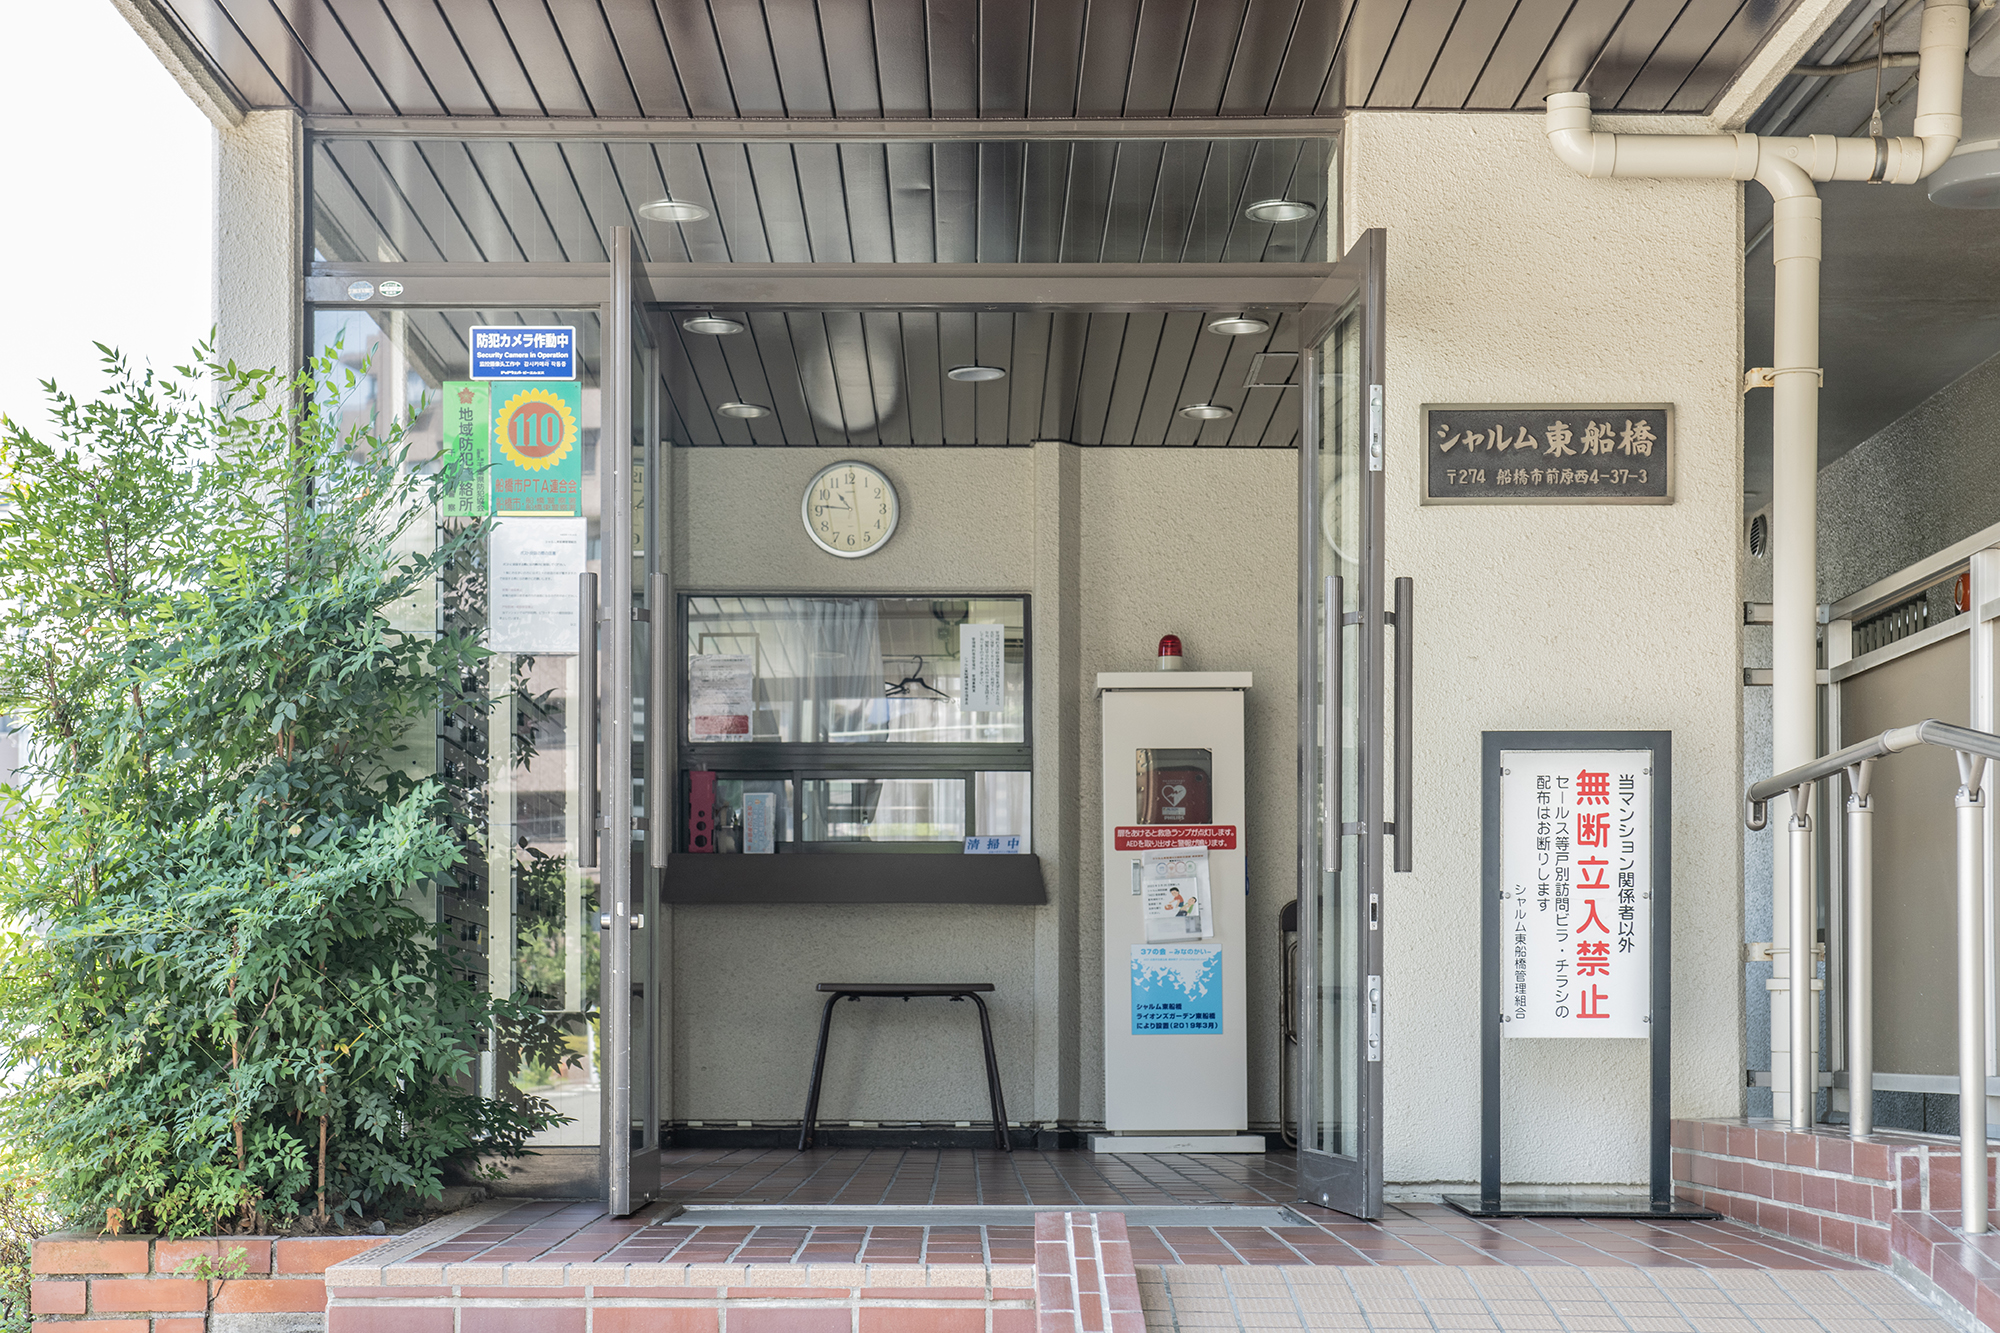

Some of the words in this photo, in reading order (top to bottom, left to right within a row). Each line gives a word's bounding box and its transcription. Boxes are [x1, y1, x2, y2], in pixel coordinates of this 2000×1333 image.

[476, 333, 569, 348] 防犯カメラ作動中
[476, 351, 503, 359] Security
[537, 351, 569, 359] Operation
[513, 413, 560, 447] 110
[1437, 419, 1658, 458] シャルム東船橋
[459, 407, 474, 511] 地域防犯絡所
[830, 477, 839, 489] 11
[864, 477, 869, 488] 1
[844, 472, 856, 485] 12
[819, 489, 831, 501] 10
[873, 487, 881, 499] 2
[814, 504, 824, 517] 9
[879, 503, 887, 515] 3
[820, 520, 829, 532] 8
[873, 519, 881, 530] 4
[832, 531, 840, 543] 7
[846, 534, 856, 546] 6
[863, 531, 871, 542] 5
[1536, 775, 1551, 912] 配布はお断りします
[1618, 774, 1635, 954] 当マンション関係者以外
[1555, 775, 1570, 1019] セールス等戸別訪問ビラ・チラシの
[1576, 769, 1611, 1019] 無断立入禁止
[1514, 884, 1527, 1020] シャルム東船橋管理組合
[1136, 1012, 1216, 1020] ライオンズガーデン東船橋
